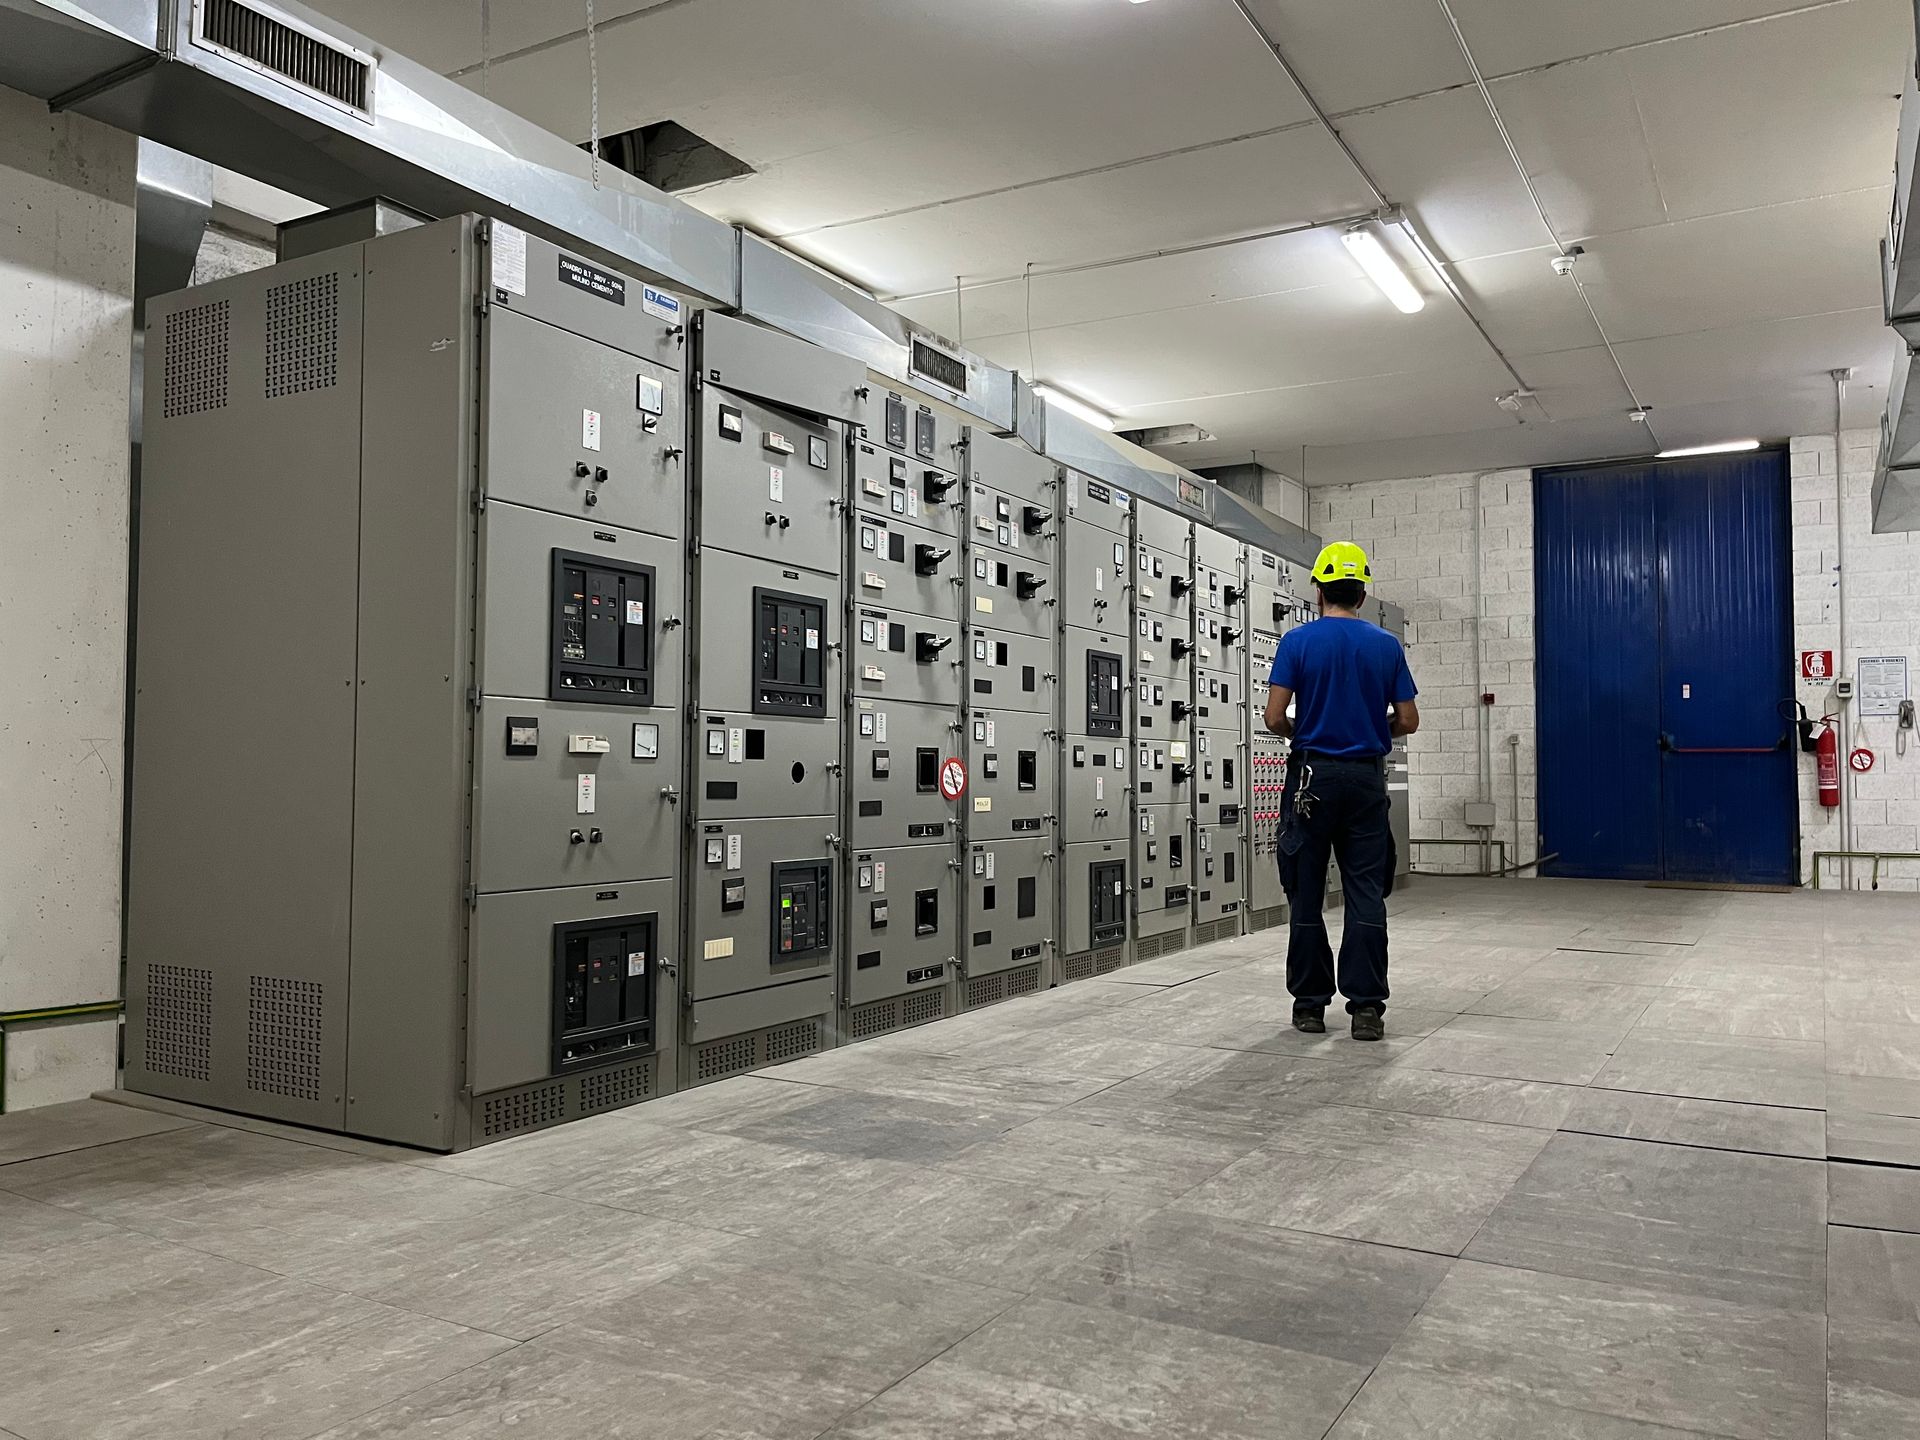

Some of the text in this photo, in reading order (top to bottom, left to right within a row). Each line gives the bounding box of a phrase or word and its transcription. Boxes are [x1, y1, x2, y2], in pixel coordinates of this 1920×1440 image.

[561, 260, 583, 275] QUADRO
[571, 273, 614, 296] MULINO CEMENTO
[1812, 666, 1824, 674] 164
